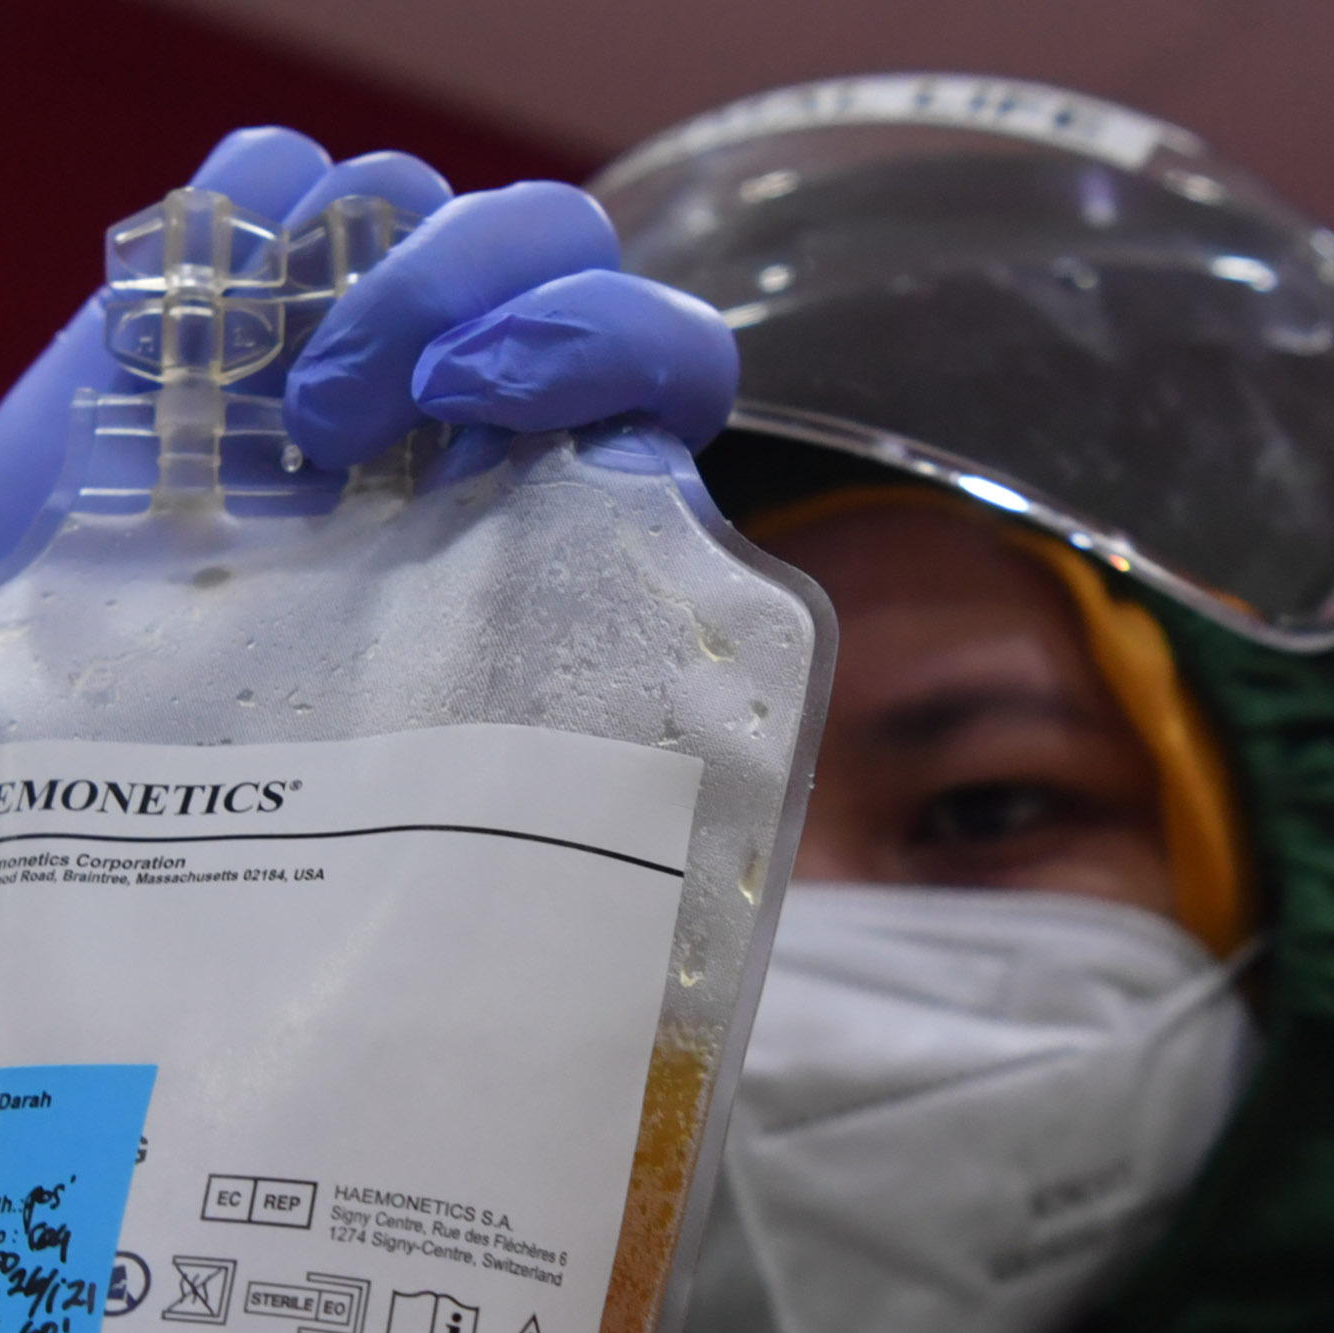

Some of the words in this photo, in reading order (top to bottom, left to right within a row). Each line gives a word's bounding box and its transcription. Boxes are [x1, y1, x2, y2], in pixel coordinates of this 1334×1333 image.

[76, 853, 186, 872] Corporation
[20, 869, 58, 884] Road,
[62, 869, 130, 887] Braintree,
[135, 870, 238, 885] Massachusetts
[242, 868, 288, 883] 02184,
[294, 868, 325, 881] USA
[216, 1190, 243, 1208] EC
[263, 1193, 301, 1213] REP
[334, 1184, 477, 1223] HAEMONETICS
[481, 1210, 514, 1232] S.A.
[330, 1205, 371, 1227] Signy
[375, 1211, 427, 1236] Centre,
[432, 1221, 460, 1241] Rue
[465, 1227, 489, 1247] des
[559, 1250, 568, 1267] 6
[329, 1225, 367, 1245] 1274
[371, 1231, 477, 1267] Signy-Centre,
[482, 1252, 563, 1287] Switzerland
[250, 1291, 315, 1313] STERILE
[323, 1300, 347, 1317] EO
